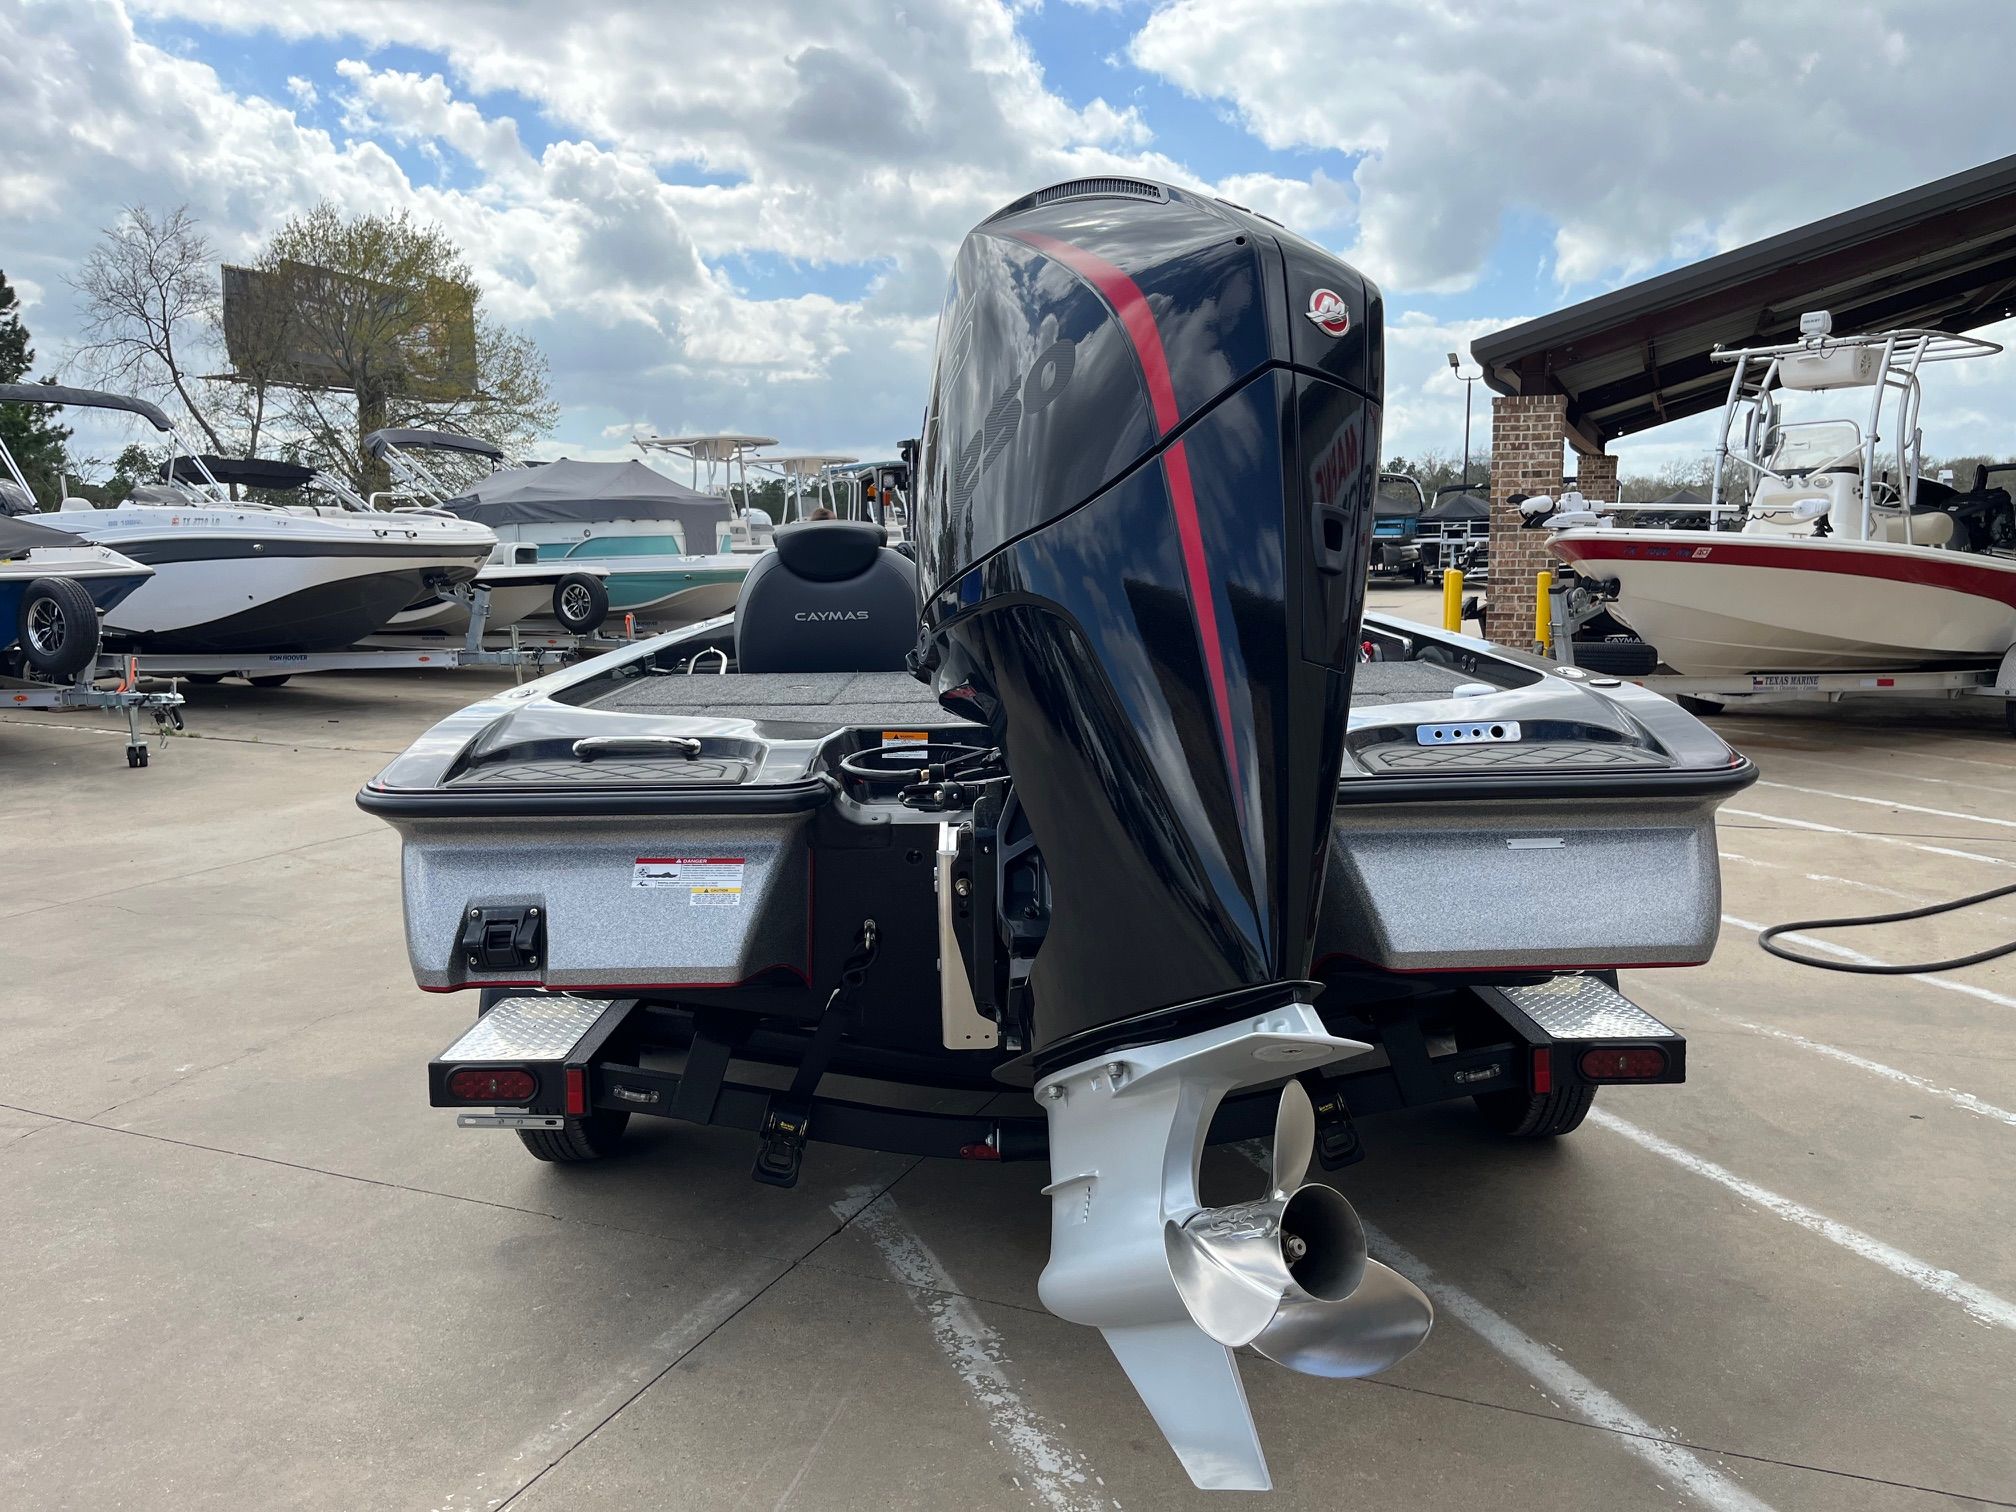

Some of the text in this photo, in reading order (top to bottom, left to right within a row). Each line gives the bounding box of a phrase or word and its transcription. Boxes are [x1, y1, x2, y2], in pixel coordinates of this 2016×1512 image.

[794, 611, 869, 621] CAYMAS
[1765, 676, 1819, 685] TEXAS MARINE
